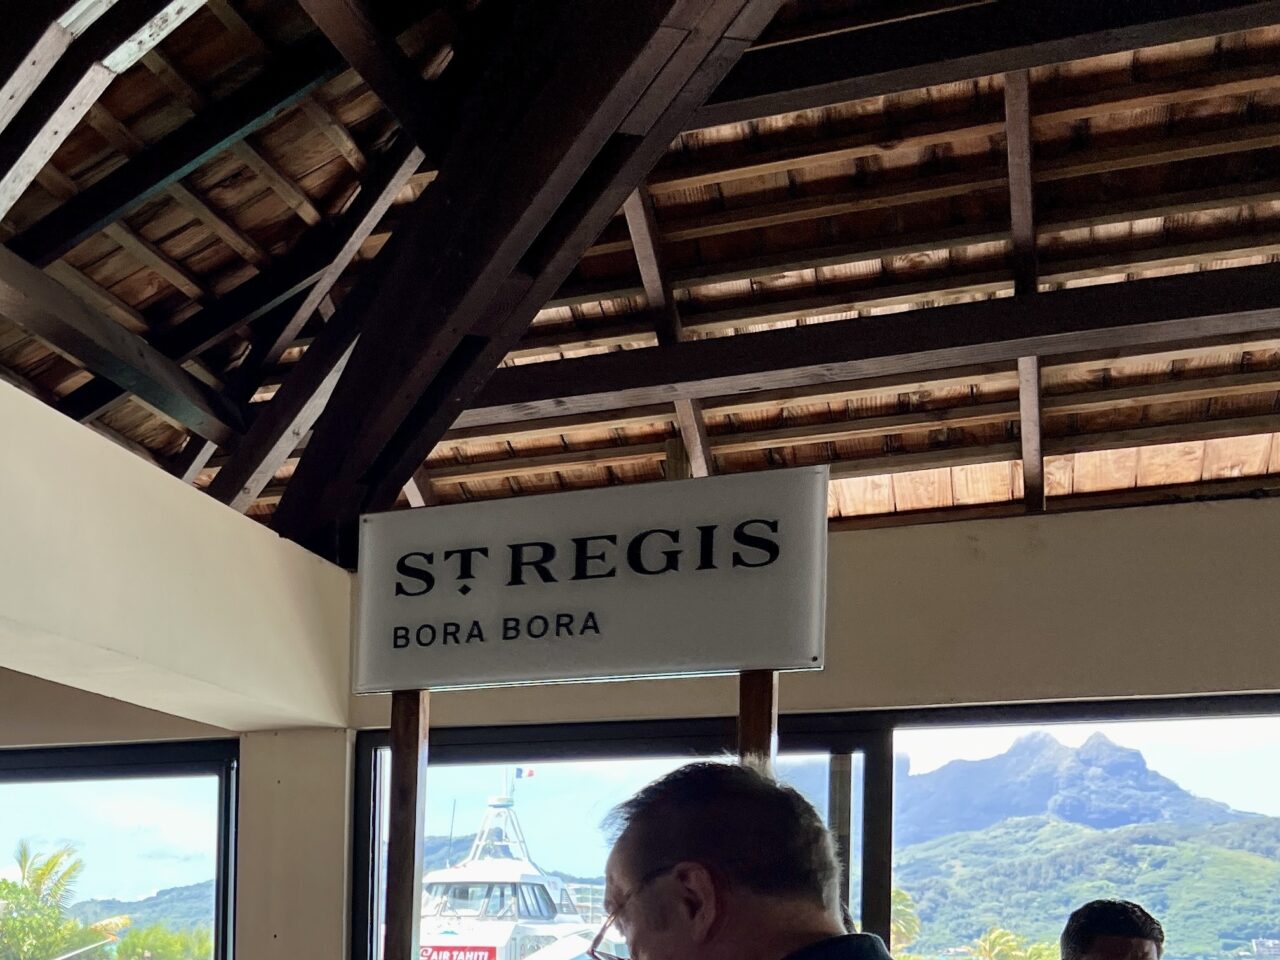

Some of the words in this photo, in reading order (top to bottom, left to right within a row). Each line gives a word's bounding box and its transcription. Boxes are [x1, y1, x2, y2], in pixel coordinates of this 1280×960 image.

[505, 519, 781, 587] REGIS
[392, 620, 485, 649] BORA
[501, 611, 601, 641] BORA
[430, 950, 450, 960] AIR
